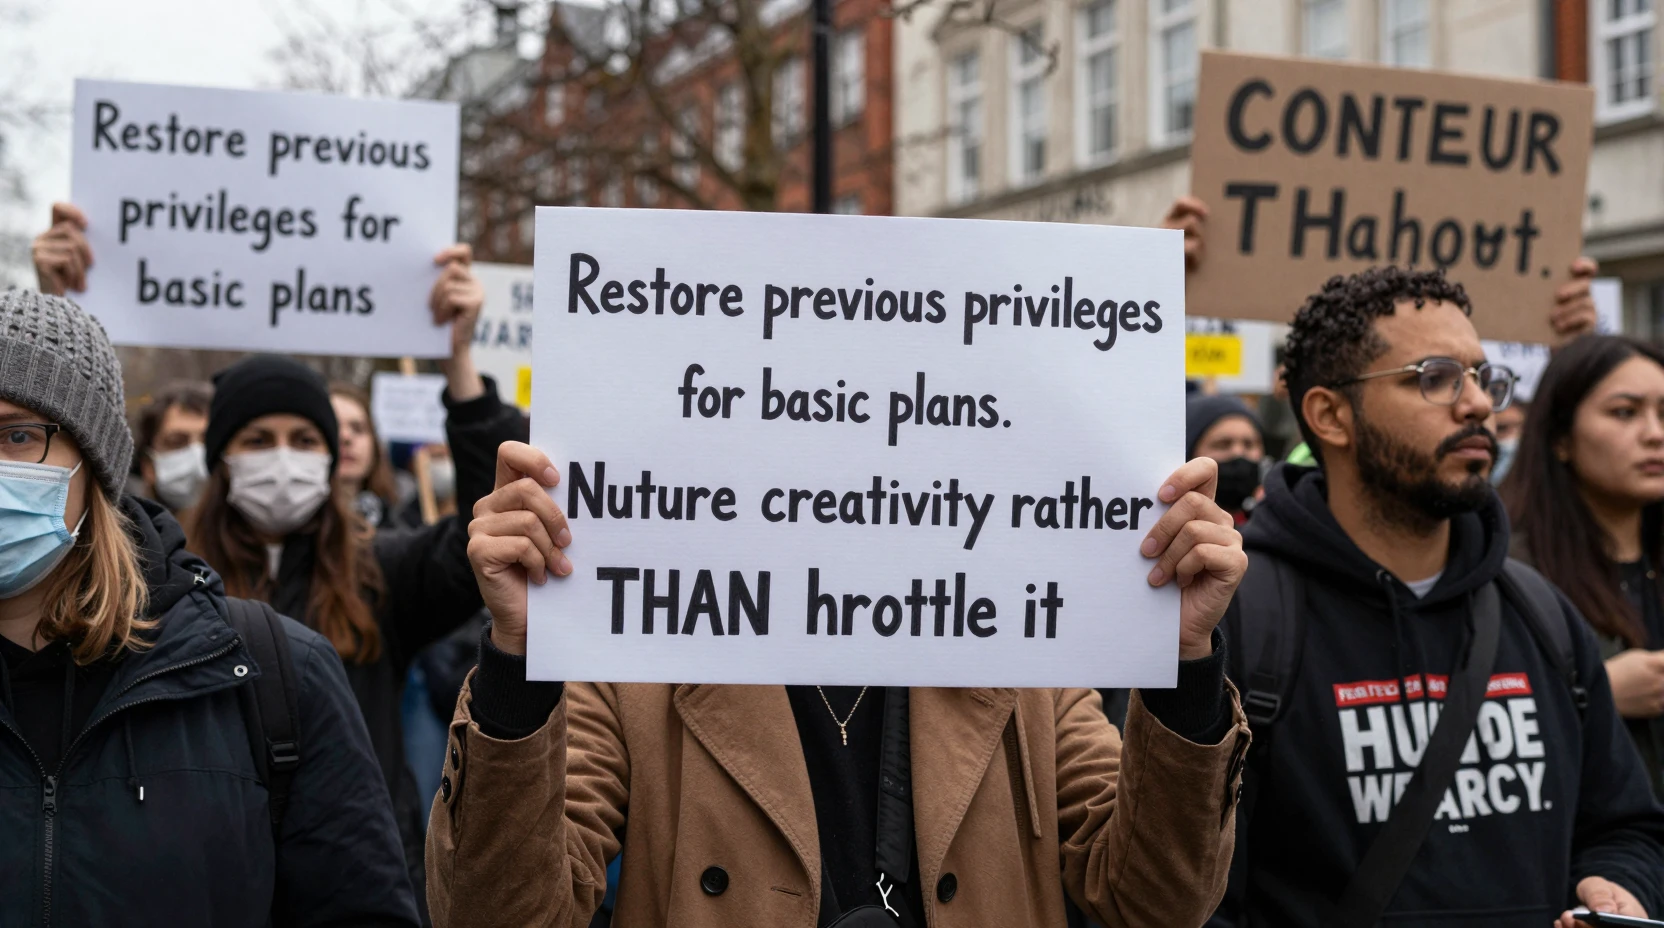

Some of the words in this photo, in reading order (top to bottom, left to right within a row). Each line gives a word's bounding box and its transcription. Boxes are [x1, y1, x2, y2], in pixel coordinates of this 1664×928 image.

[93, 101, 246, 158] Restore
[269, 131, 430, 176] previous
[1226, 79, 1561, 174] CONTEUR
[119, 190, 317, 252] privileges
[342, 196, 399, 242] for
[138, 259, 245, 309] basic
[271, 268, 374, 326] plans
[568, 252, 745, 318] Restore
[763, 277, 947, 340] previous
[964, 276, 1163, 352] privileges
[678, 363, 746, 419] for
[761, 366, 871, 424] basic
[888, 371, 1012, 447] plans.
[567, 461, 738, 522] Nuture
[761, 475, 995, 551] creativity
[1011, 475, 1154, 531] rather
[596, 566, 771, 637] THAN
[806, 567, 998, 639] hrottle
[1024, 581, 1064, 639] it
